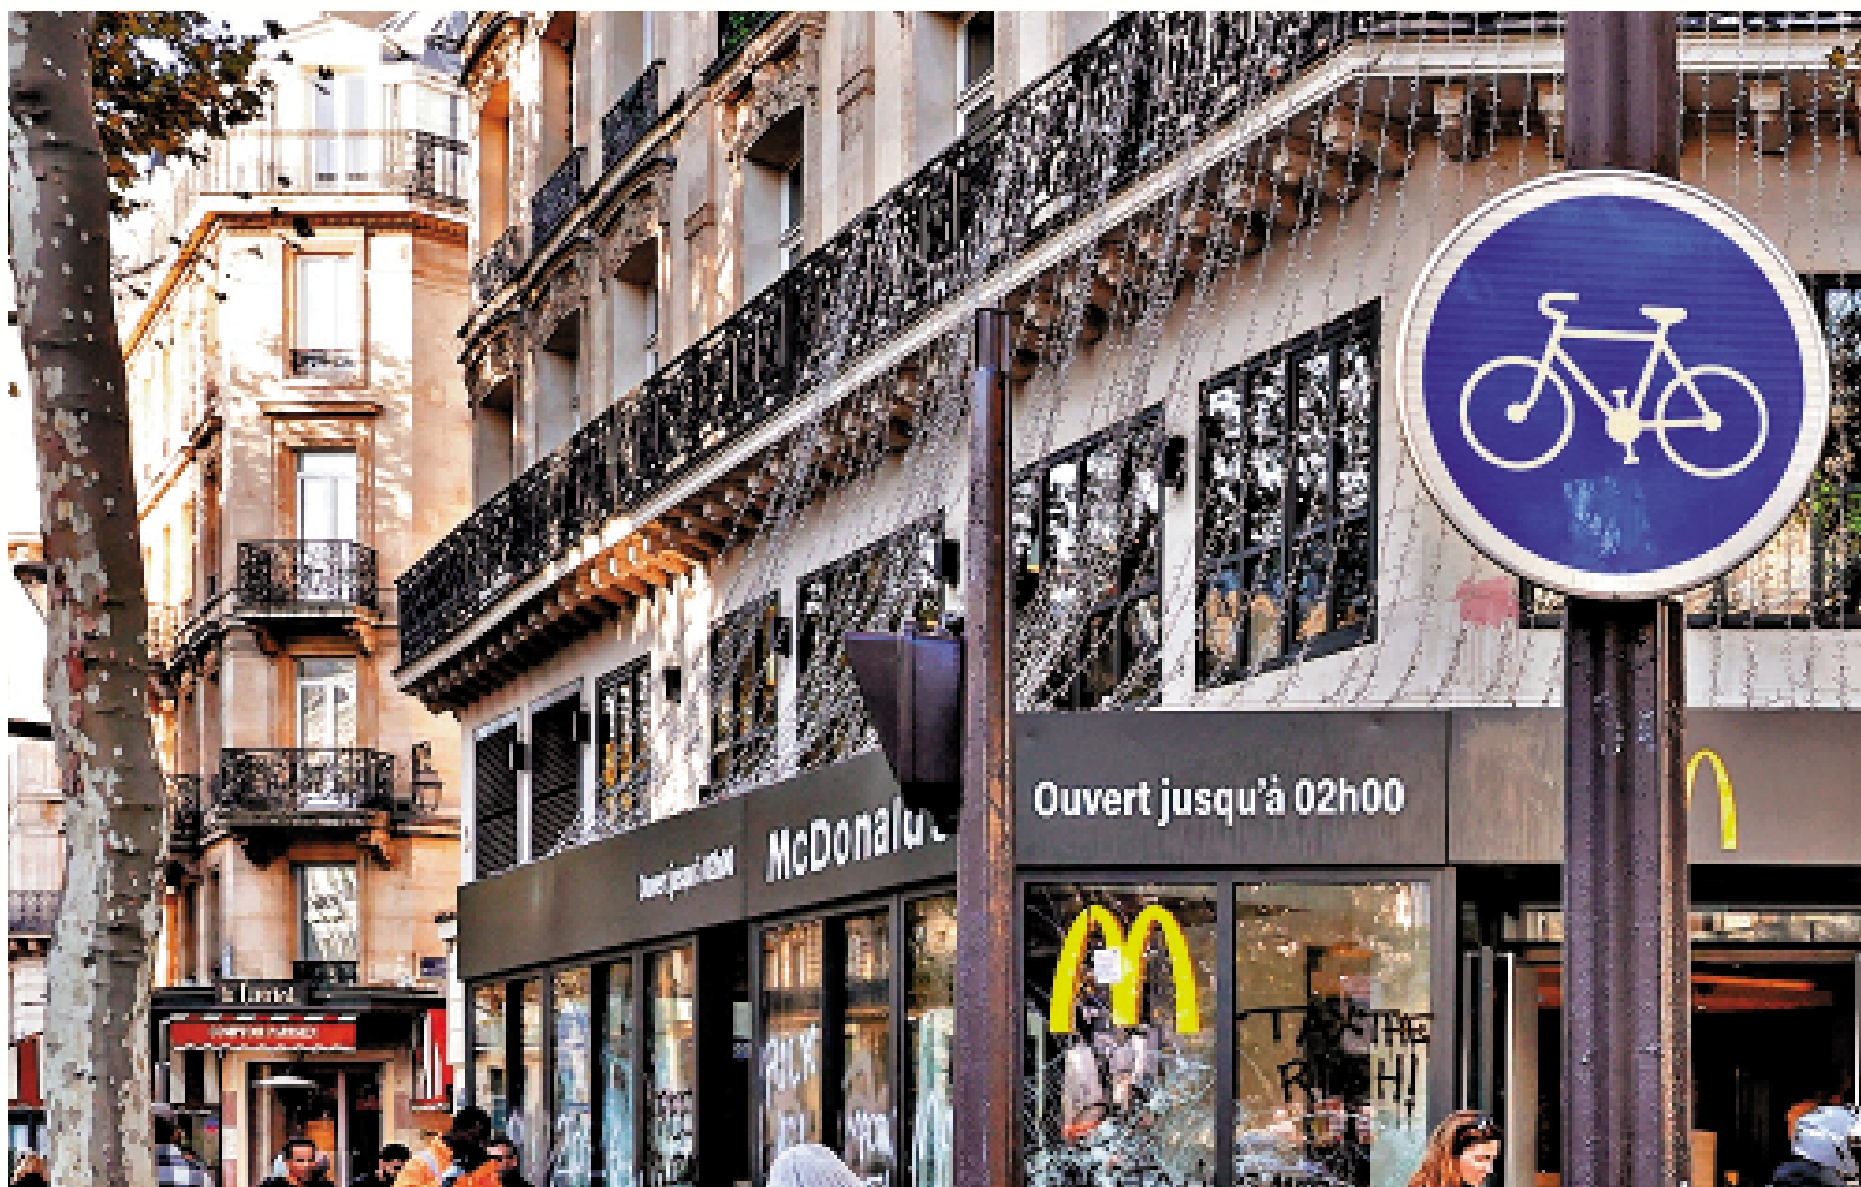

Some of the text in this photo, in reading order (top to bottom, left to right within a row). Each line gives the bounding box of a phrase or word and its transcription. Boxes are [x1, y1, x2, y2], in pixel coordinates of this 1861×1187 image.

[1033, 780, 1151, 816] Ouvert
[1295, 778, 1405, 816] 02h00
[765, 797, 948, 883] McDonal
